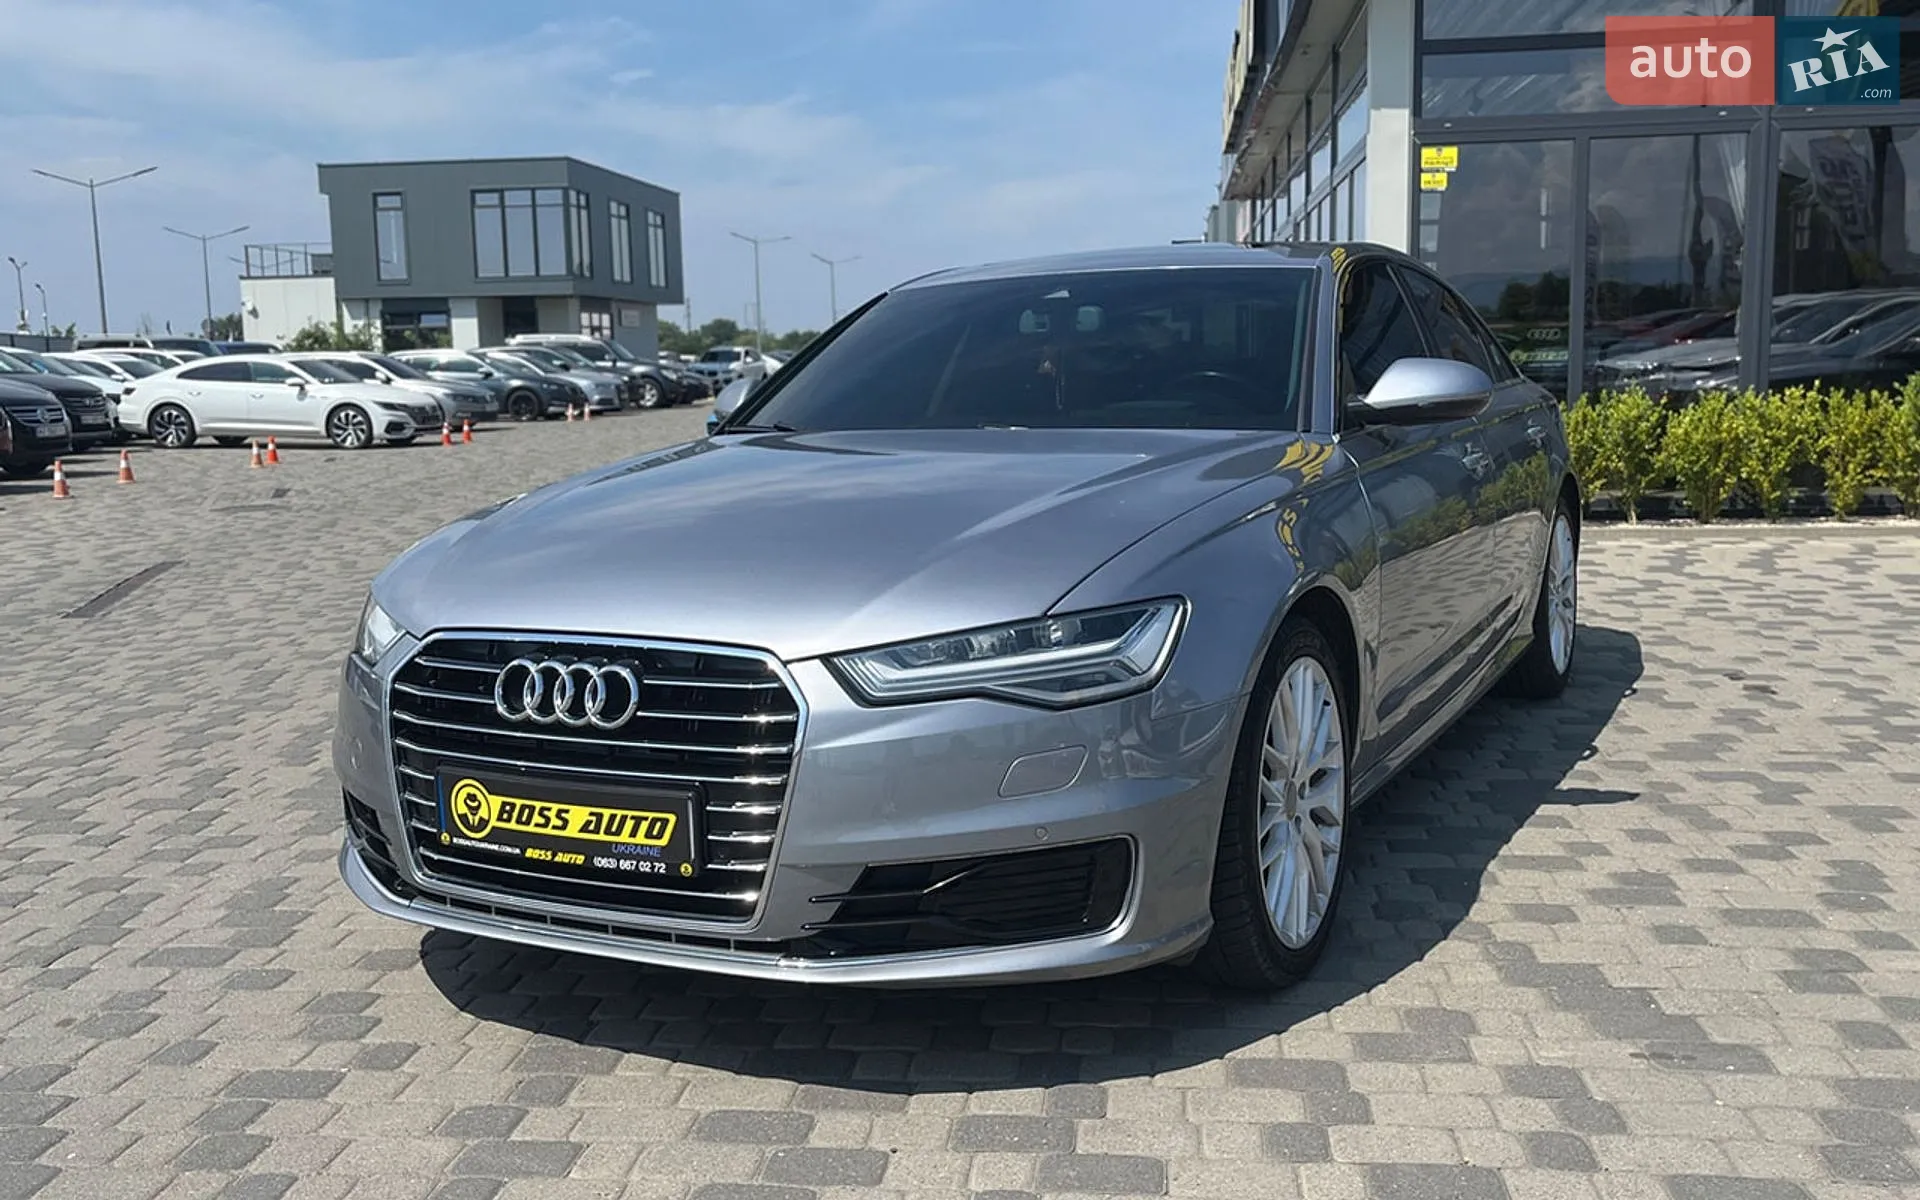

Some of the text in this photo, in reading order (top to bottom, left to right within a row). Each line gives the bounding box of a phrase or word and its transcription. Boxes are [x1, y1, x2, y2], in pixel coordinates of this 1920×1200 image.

[496, 801, 670, 840] BOSS AUTO
[525, 848, 585, 865] BOSS AUTO
[611, 843, 661, 857] UKRAINE
[638, 861, 652, 872] 02
[653, 863, 667, 873] 72
